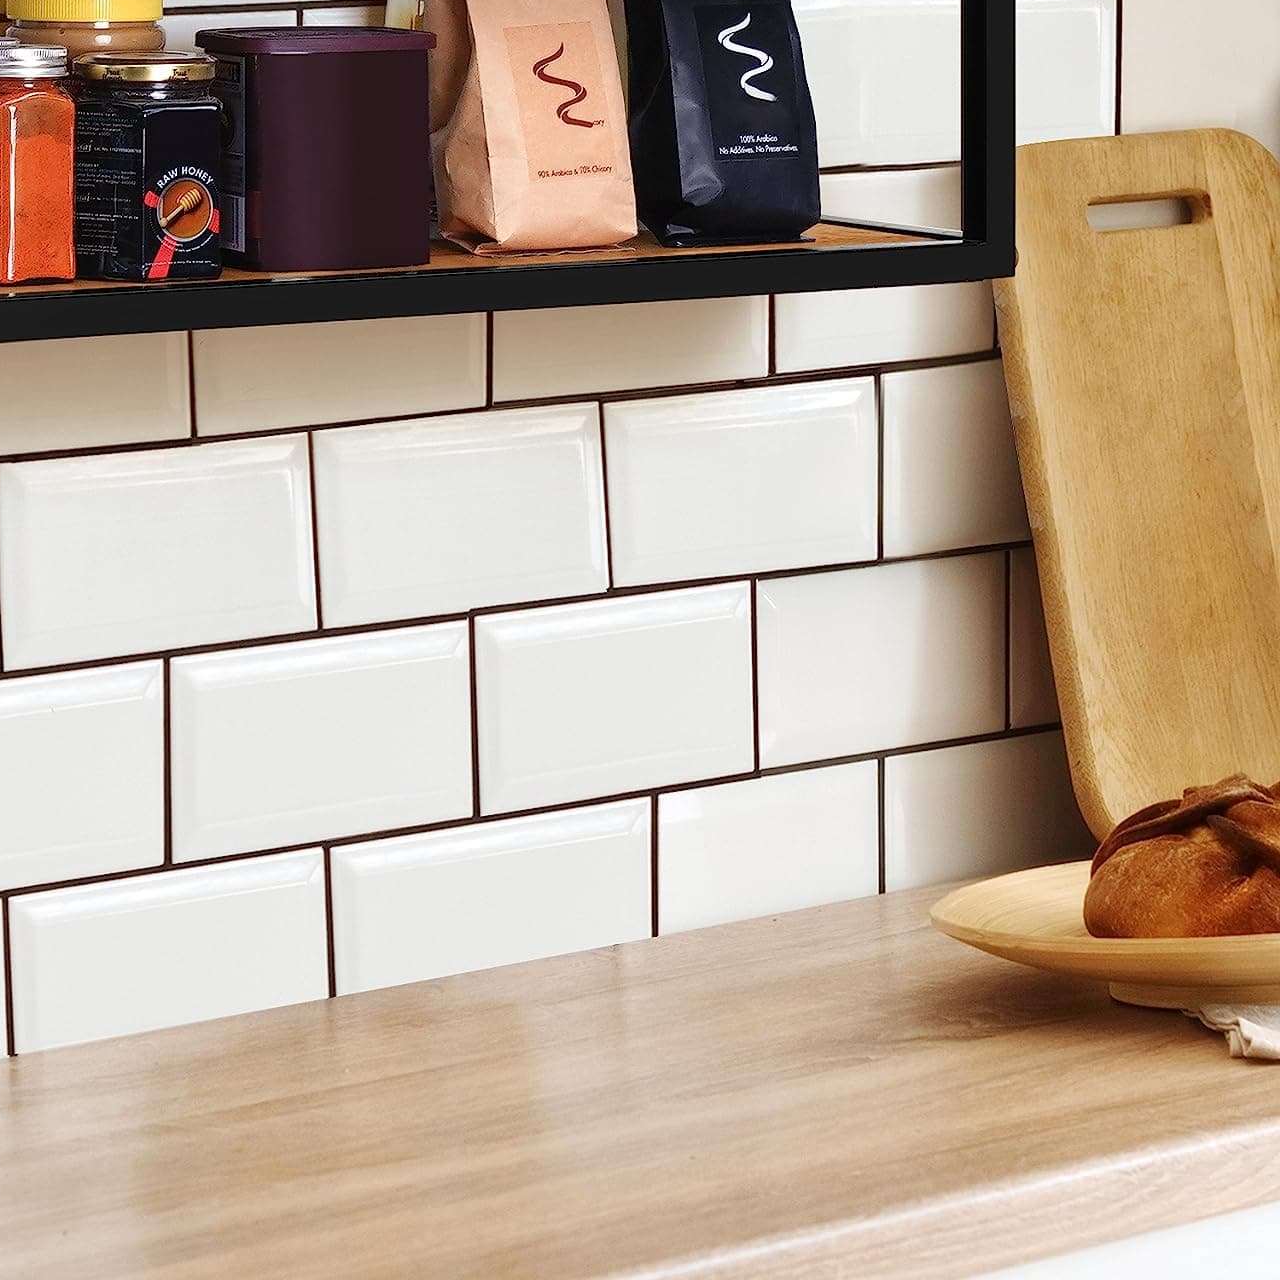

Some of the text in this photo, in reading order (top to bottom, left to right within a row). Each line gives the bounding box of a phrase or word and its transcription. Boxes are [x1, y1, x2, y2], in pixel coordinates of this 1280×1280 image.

[740, 134, 755, 144] 100%
[719, 147, 729, 155] No
[755, 145, 765, 153] No
[156, 167, 179, 189] RAW
[181, 166, 214, 185] HONEY
